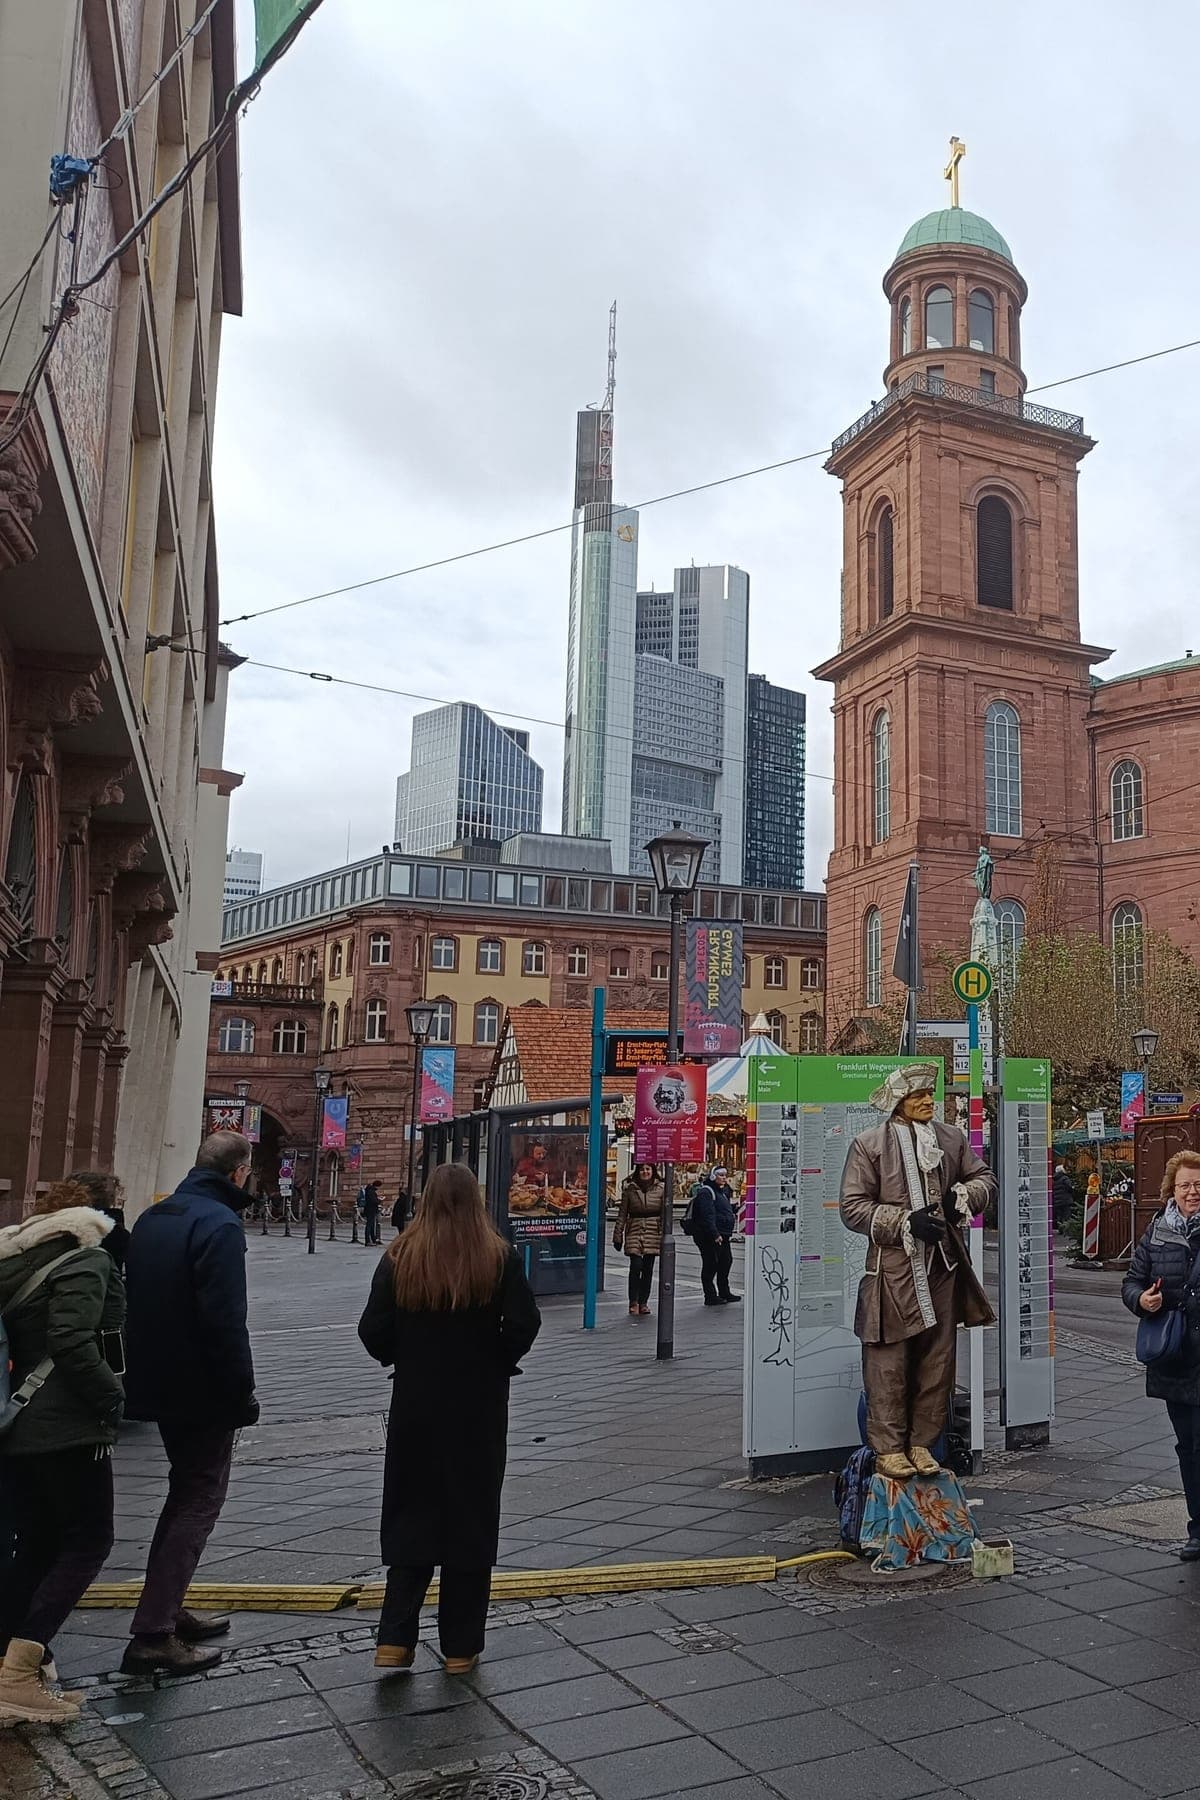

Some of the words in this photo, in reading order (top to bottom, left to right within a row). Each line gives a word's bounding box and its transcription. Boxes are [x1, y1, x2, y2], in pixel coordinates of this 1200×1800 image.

[965, 970, 981, 994] H
[836, 1063, 868, 1071] Frankfurt
[955, 1061, 969, 1069] N12
